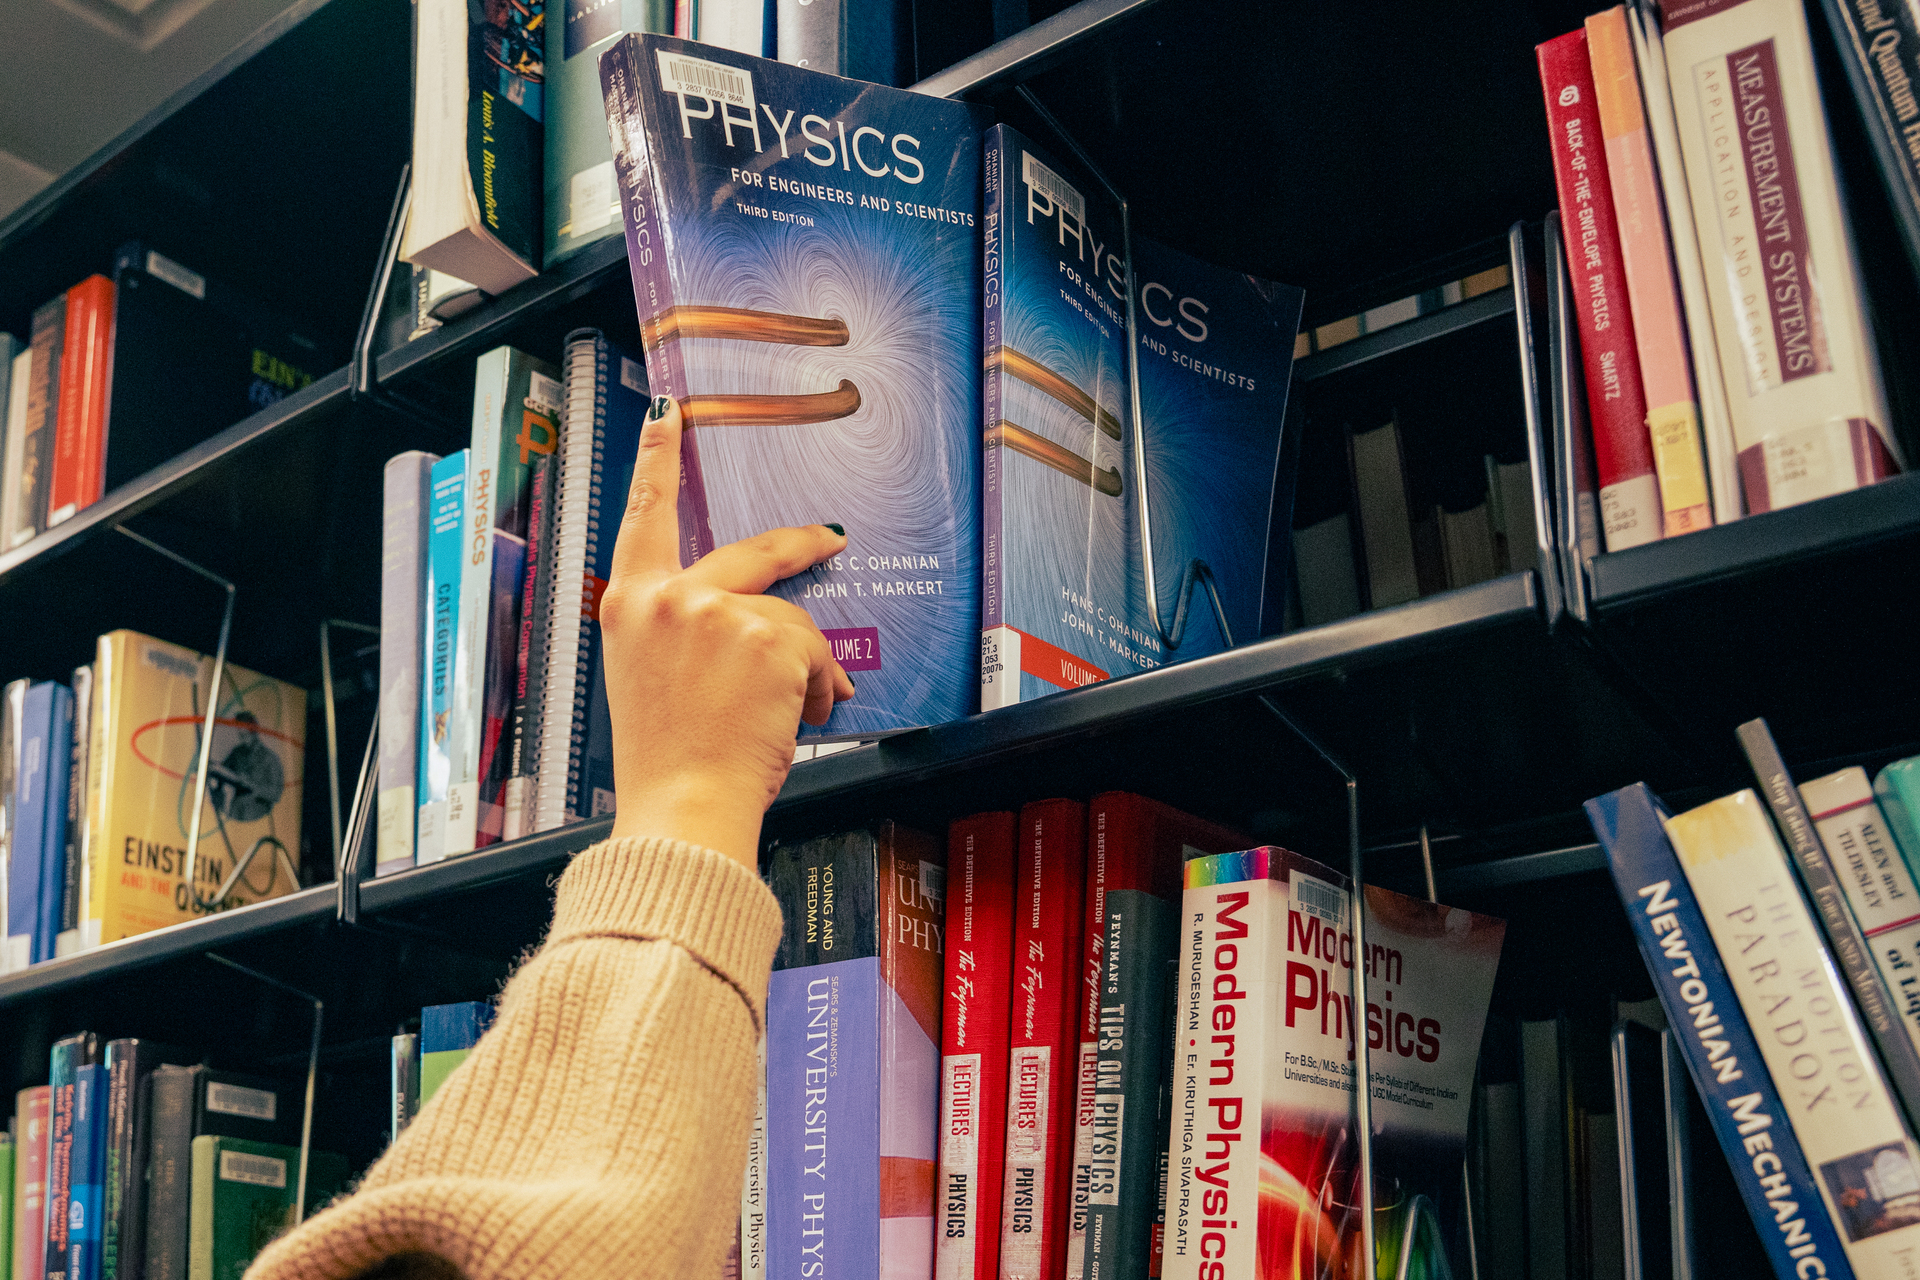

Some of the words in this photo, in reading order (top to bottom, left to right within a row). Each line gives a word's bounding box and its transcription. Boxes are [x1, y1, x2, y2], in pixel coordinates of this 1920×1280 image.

[483, 90, 494, 130] Louis
[677, 82, 682, 90] 3
[677, 92, 924, 184] PHYSICS
[483, 149, 499, 228] Bloomfield
[626, 152, 653, 267] PHYSICS
[731, 168, 763, 188] FOR
[769, 176, 854, 205] ENGINEERS
[860, 194, 890, 212] AND
[896, 201, 974, 227] SCIENTISTS
[736, 203, 769, 219] THIRD
[772, 210, 815, 228] EDITION
[1566, 118, 1602, 270] BACK-OF-THE-ENVELOPE
[1735, 54, 1791, 245] MEASUREMENT
[1768, 250, 1813, 373] SYSTEMS
[1703, 69, 1741, 219] APPLICATION
[1732, 234, 1752, 279] AND
[1742, 293, 1770, 381] DESIGN
[985, 213, 998, 308] PHYSICS
[1027, 184, 1210, 342] PHYSCS
[648, 281, 657, 307] FOR
[653, 311, 670, 381] ENGINEERS
[988, 321, 996, 341] FOR
[1060, 289, 1083, 312] THIRD
[1084, 308, 1110, 339] EDITION
[1060, 261, 1081, 287] FOR
[1141, 334, 1167, 356] AND
[1172, 350, 1255, 391] SCIENTISTS
[1589, 274, 1610, 331] PHYSICS
[988, 344, 996, 403] ENGINEERS
[1599, 351, 1621, 401] SWARTZ
[988, 407, 996, 428] AND
[533, 470, 545, 496] The
[988, 431, 996, 492] SCIENTISTS
[472, 469, 491, 567] PHYSICS
[527, 499, 542, 563] Materials
[849, 556, 864, 570] C.
[868, 556, 939, 570] OHANIAN
[988, 534, 996, 575] THIRD
[523, 565, 538, 617] Physics
[804, 583, 848, 599] JOHN
[853, 583, 866, 596] T.
[872, 581, 943, 596] MARKERT
[988, 577, 996, 616] EDITION
[435, 583, 451, 697] CATEGORIES
[982, 636, 992, 646] QC
[1061, 611, 1094, 637] JOHN
[1098, 629, 1106, 645] T.
[1062, 586, 1094, 614] HANS
[1098, 608, 1107, 623] C.
[1109, 615, 1160, 653] OHANIAN
[517, 620, 533, 699] Companion
[865, 638, 873, 659] 2
[982, 663, 1003, 675] 2007b
[982, 675, 993, 684] v.3
[1034, 819, 1042, 837] THE
[965, 853, 974, 904] DEFINITIVE
[1033, 839, 1042, 890] DEFINITIVE
[1096, 831, 1106, 885] DEFINITIVE
[1836, 830, 1883, 909] TILDESLEY
[1859, 822, 1890, 869] ALLEN
[1881, 872, 1906, 901] and
[806, 866, 818, 943] FREEDMAN
[823, 863, 833, 915] YOUNG
[1032, 891, 1041, 929] EDITION
[1094, 886, 1104, 924] EDITION
[823, 919, 833, 951] AND
[964, 906, 973, 942] EDITION
[1194, 912, 1204, 927] R.
[959, 950, 976, 971] The
[1028, 939, 1045, 961] The
[1107, 913, 1122, 994] FEYNMAN'S
[1887, 948, 1912, 970] of
[830, 975, 839, 1006] SEARS
[1020, 965, 1043, 1039] Feynman
[1188, 930, 1203, 1030] MURUGESHAN
[1208, 891, 1249, 1086] Modern
[1759, 882, 1800, 943] THE
[1793, 967, 1873, 1110] MOTION
[830, 1007, 838, 1015] &
[951, 975, 974, 1047] Feynman
[1099, 1004, 1125, 1051] TIPS
[1726, 906, 1837, 1112] PARADOX
[829, 1016, 839, 1078] ZEMANSKY'S
[1096, 1060, 1122, 1088] ON
[1187, 1054, 1198, 1071] Er.
[804, 976, 830, 1181] UNIVERSITY
[951, 1064, 972, 1136] LECTURES
[1017, 1056, 1039, 1129] LECTURES
[1284, 1052, 1299, 1065] For
[1300, 1054, 1341, 1074] B.Sc./M.Sc.
[1376, 1073, 1386, 1084] Per
[1410, 1081, 1436, 1097] Different
[1436, 1085, 1458, 1100] Indian
[1284, 1067, 1329, 1087] Universities
[1329, 1078, 1341, 1090] and
[1373, 1088, 1386, 1100] UGC
[1403, 1093, 1434, 1110] Curriculum
[1638, 880, 1743, 1085] NEWTONIAN
[1727, 1092, 1828, 1280] MECHANIC
[1181, 1074, 1197, 1153] KIRUTHIGA
[1090, 1102, 1119, 1194] PHYSICS
[946, 1174, 967, 1239] PHYSICS
[1013, 1168, 1035, 1234] PHYSICS
[1176, 1156, 1192, 1256] SIVAPRASATH
[1195, 1097, 1243, 1280] Physics
[750, 1211, 764, 1269] Physics
[1094, 1213, 1103, 1253] FEYNMAN
